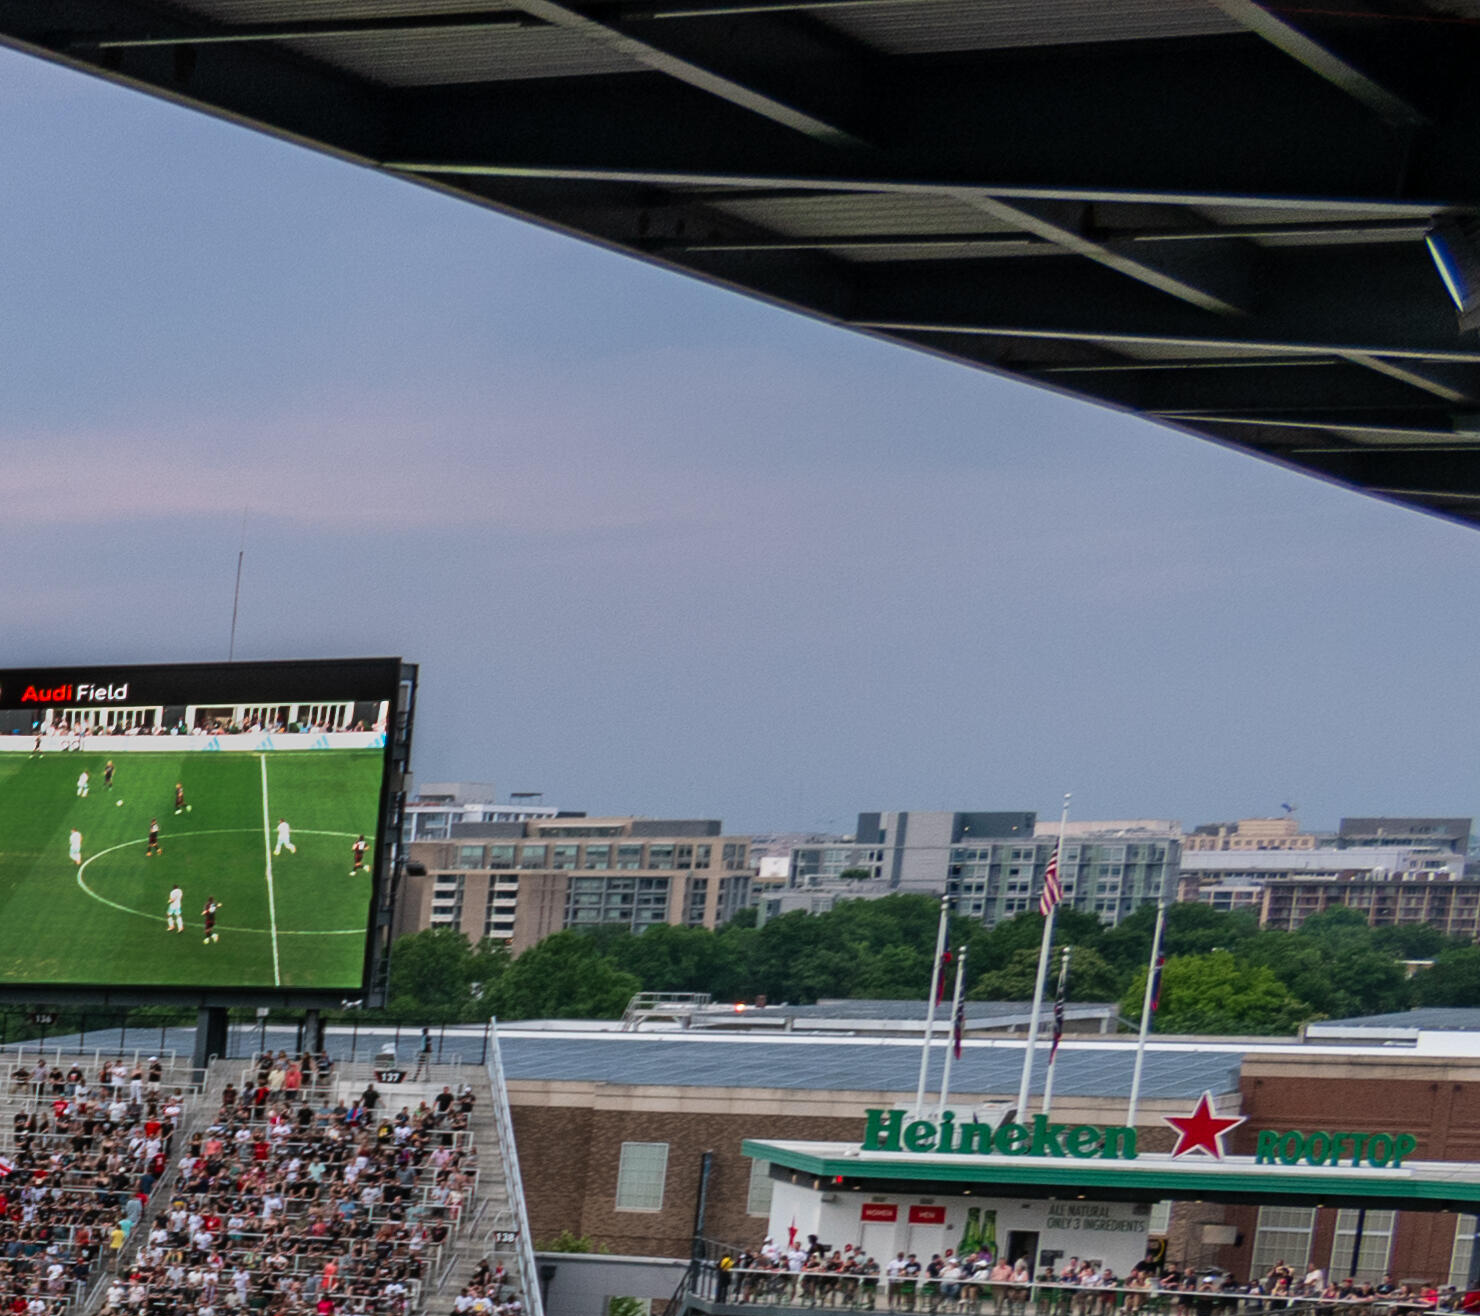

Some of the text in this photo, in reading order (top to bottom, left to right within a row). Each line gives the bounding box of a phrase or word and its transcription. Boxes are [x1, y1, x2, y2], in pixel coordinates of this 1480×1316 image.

[21, 682, 129, 702] Audi Field
[860, 1108, 1418, 1169] Heineken ROOFTOP
